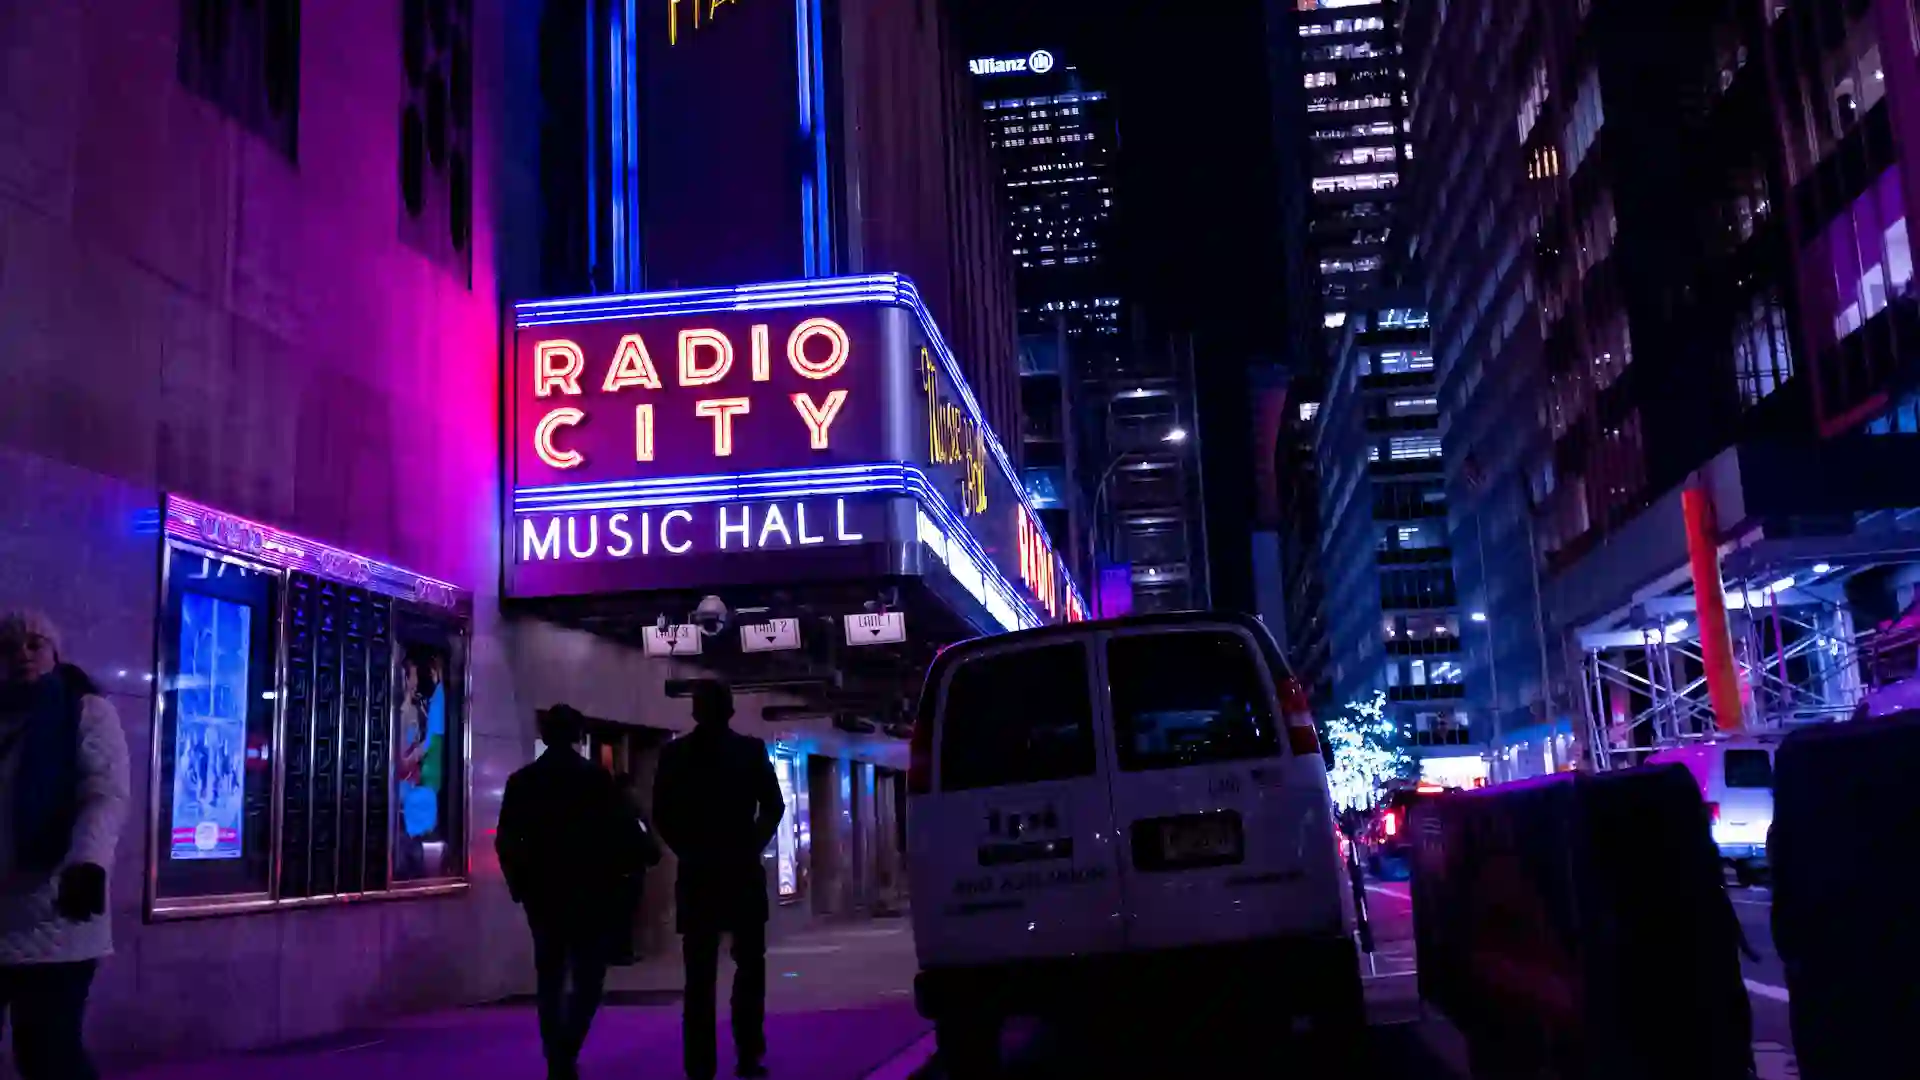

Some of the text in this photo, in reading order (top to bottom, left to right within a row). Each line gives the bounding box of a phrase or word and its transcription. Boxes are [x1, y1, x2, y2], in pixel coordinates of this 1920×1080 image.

[533, 317, 850, 397] RADIO
[534, 390, 848, 469] CITY
[523, 498, 863, 561] MUSIC HALL
